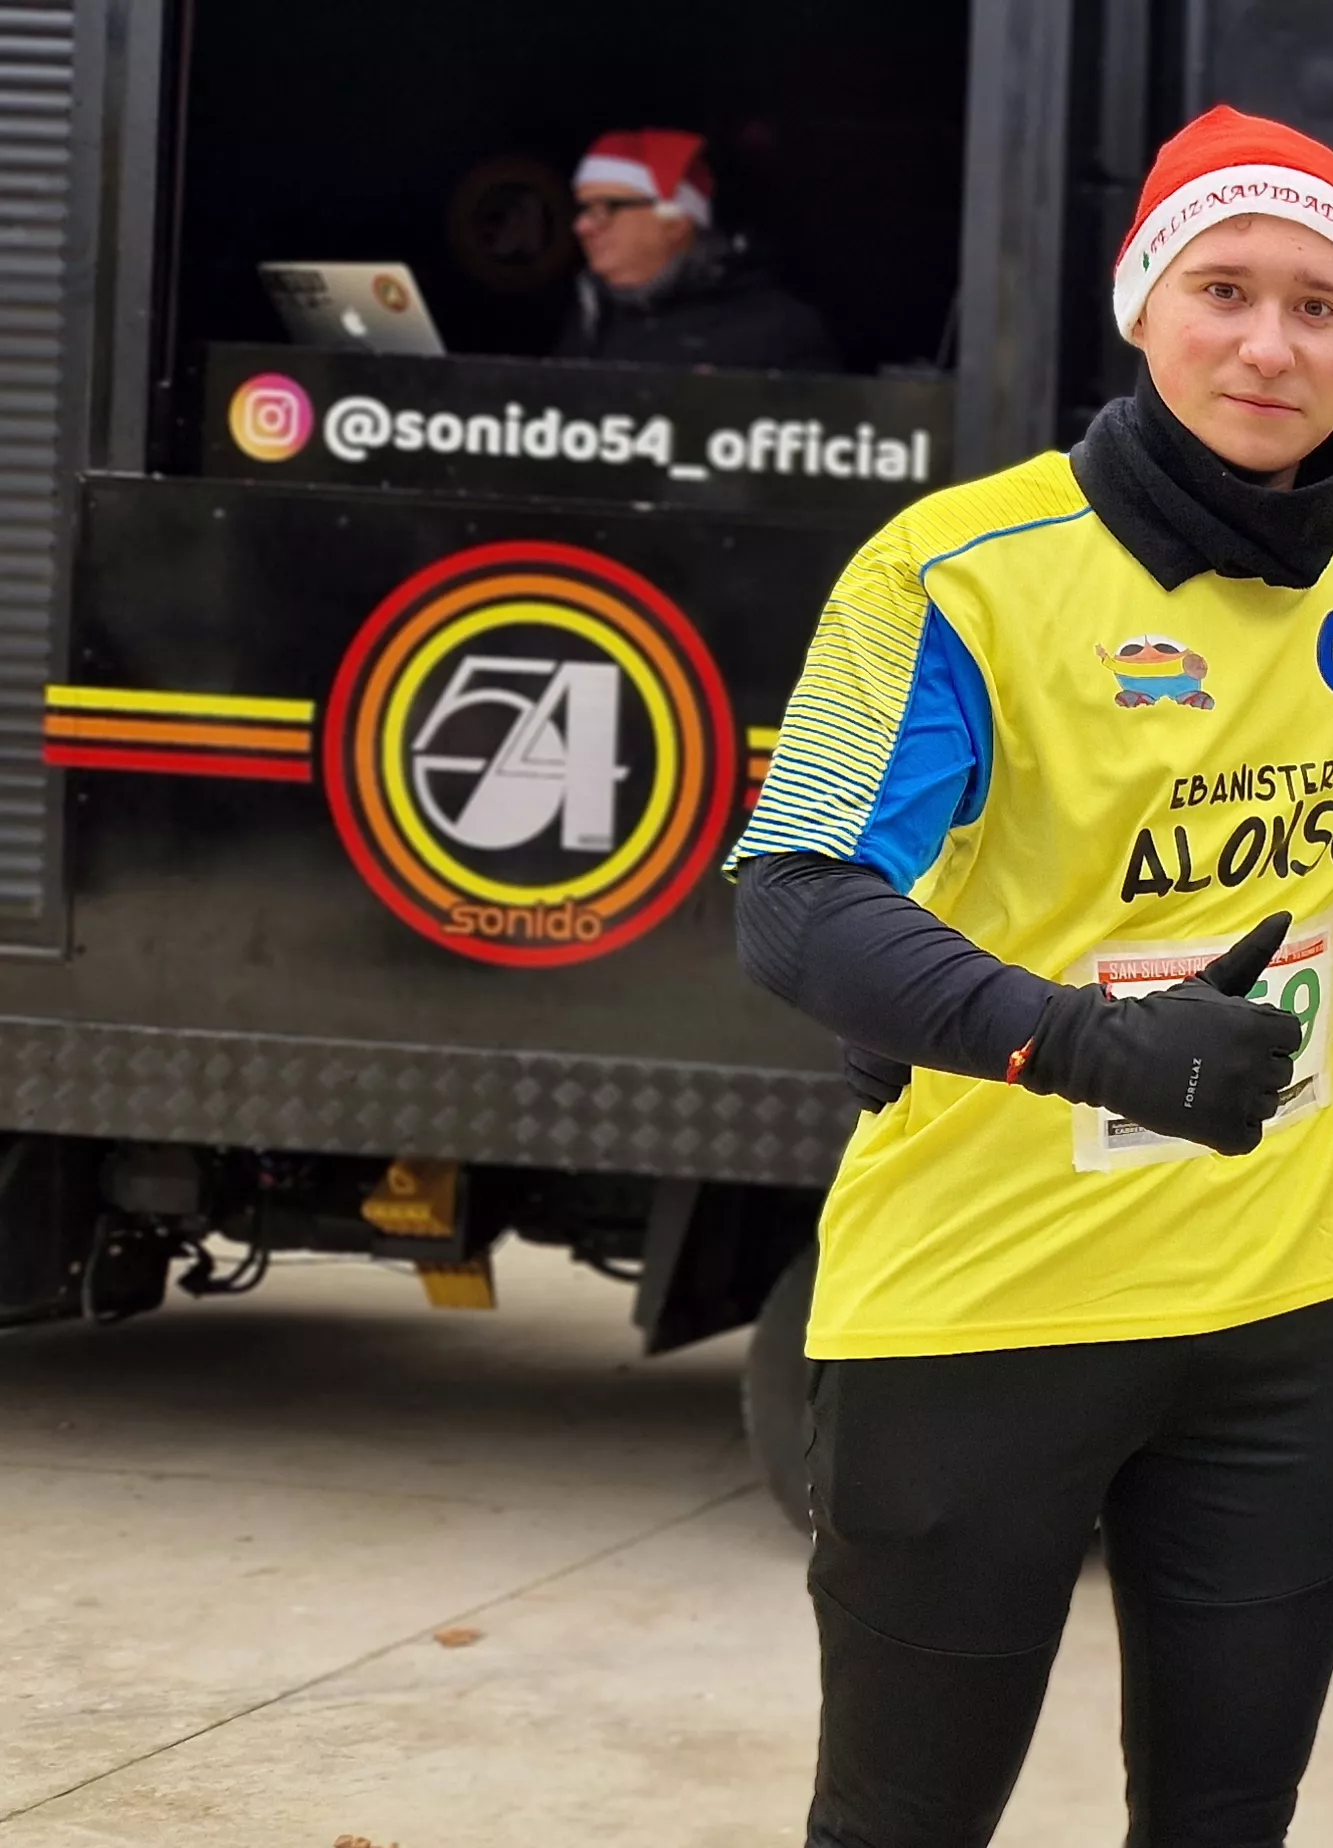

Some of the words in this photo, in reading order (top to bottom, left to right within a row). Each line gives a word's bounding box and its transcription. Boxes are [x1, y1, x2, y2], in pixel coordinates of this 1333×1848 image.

[1150, 199, 1202, 253] FELIZ
[324, 396, 929, 480] @sonido54_official
[443, 900, 603, 940] sonido
[1109, 963, 1137, 980] SAN
[1184, 1057, 1202, 1108] FORCLAZ
